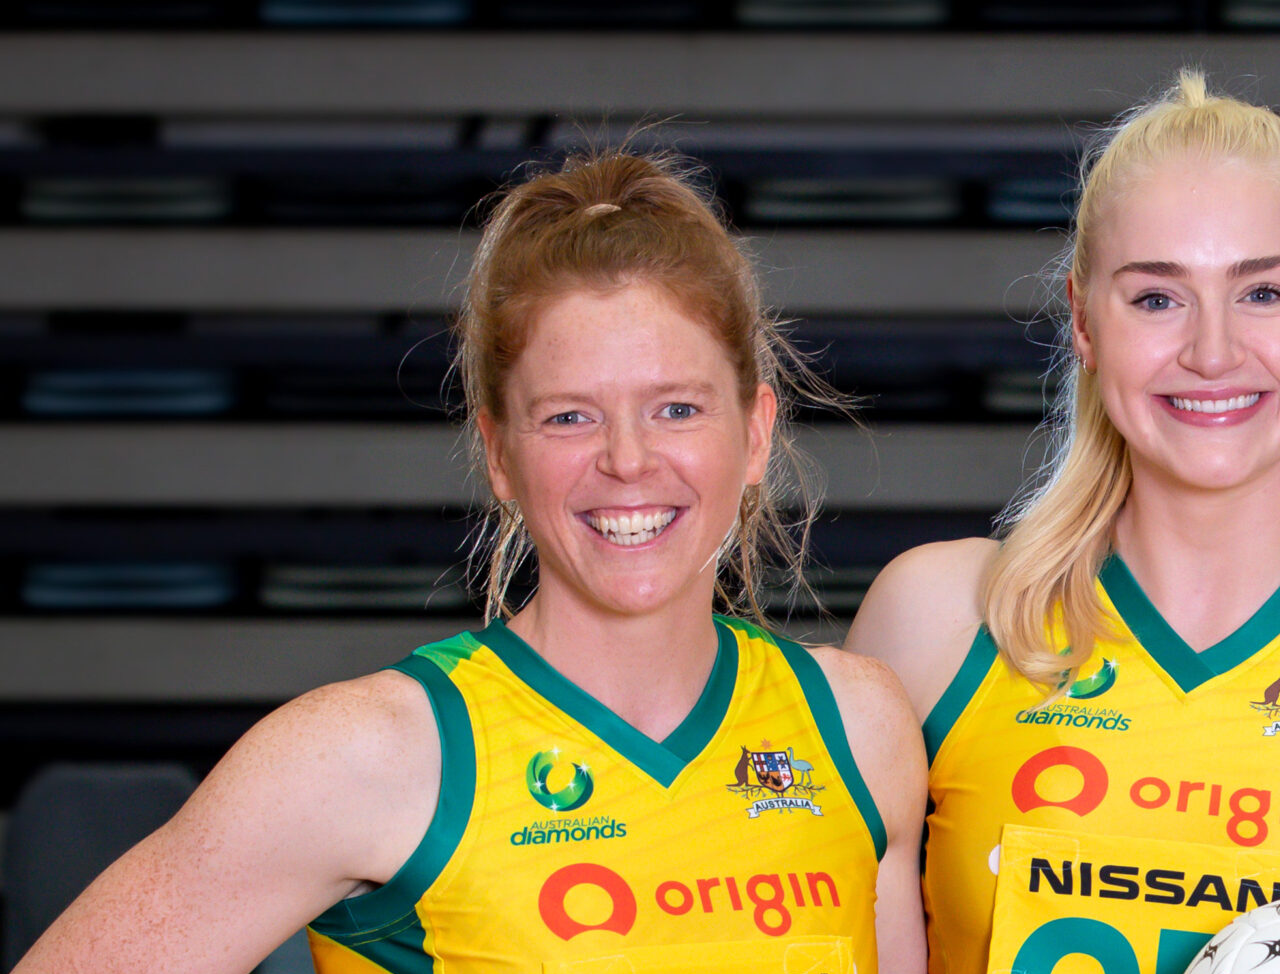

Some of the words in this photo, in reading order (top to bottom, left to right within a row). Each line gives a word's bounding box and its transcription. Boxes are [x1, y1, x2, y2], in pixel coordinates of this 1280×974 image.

[1015, 709, 1132, 732] diamonds
[755, 799, 811, 811] AUSTRALIA
[510, 819, 627, 846] diamonds
[530, 815, 610, 831] AUSTRALIAN
[656, 871, 841, 937] origin
